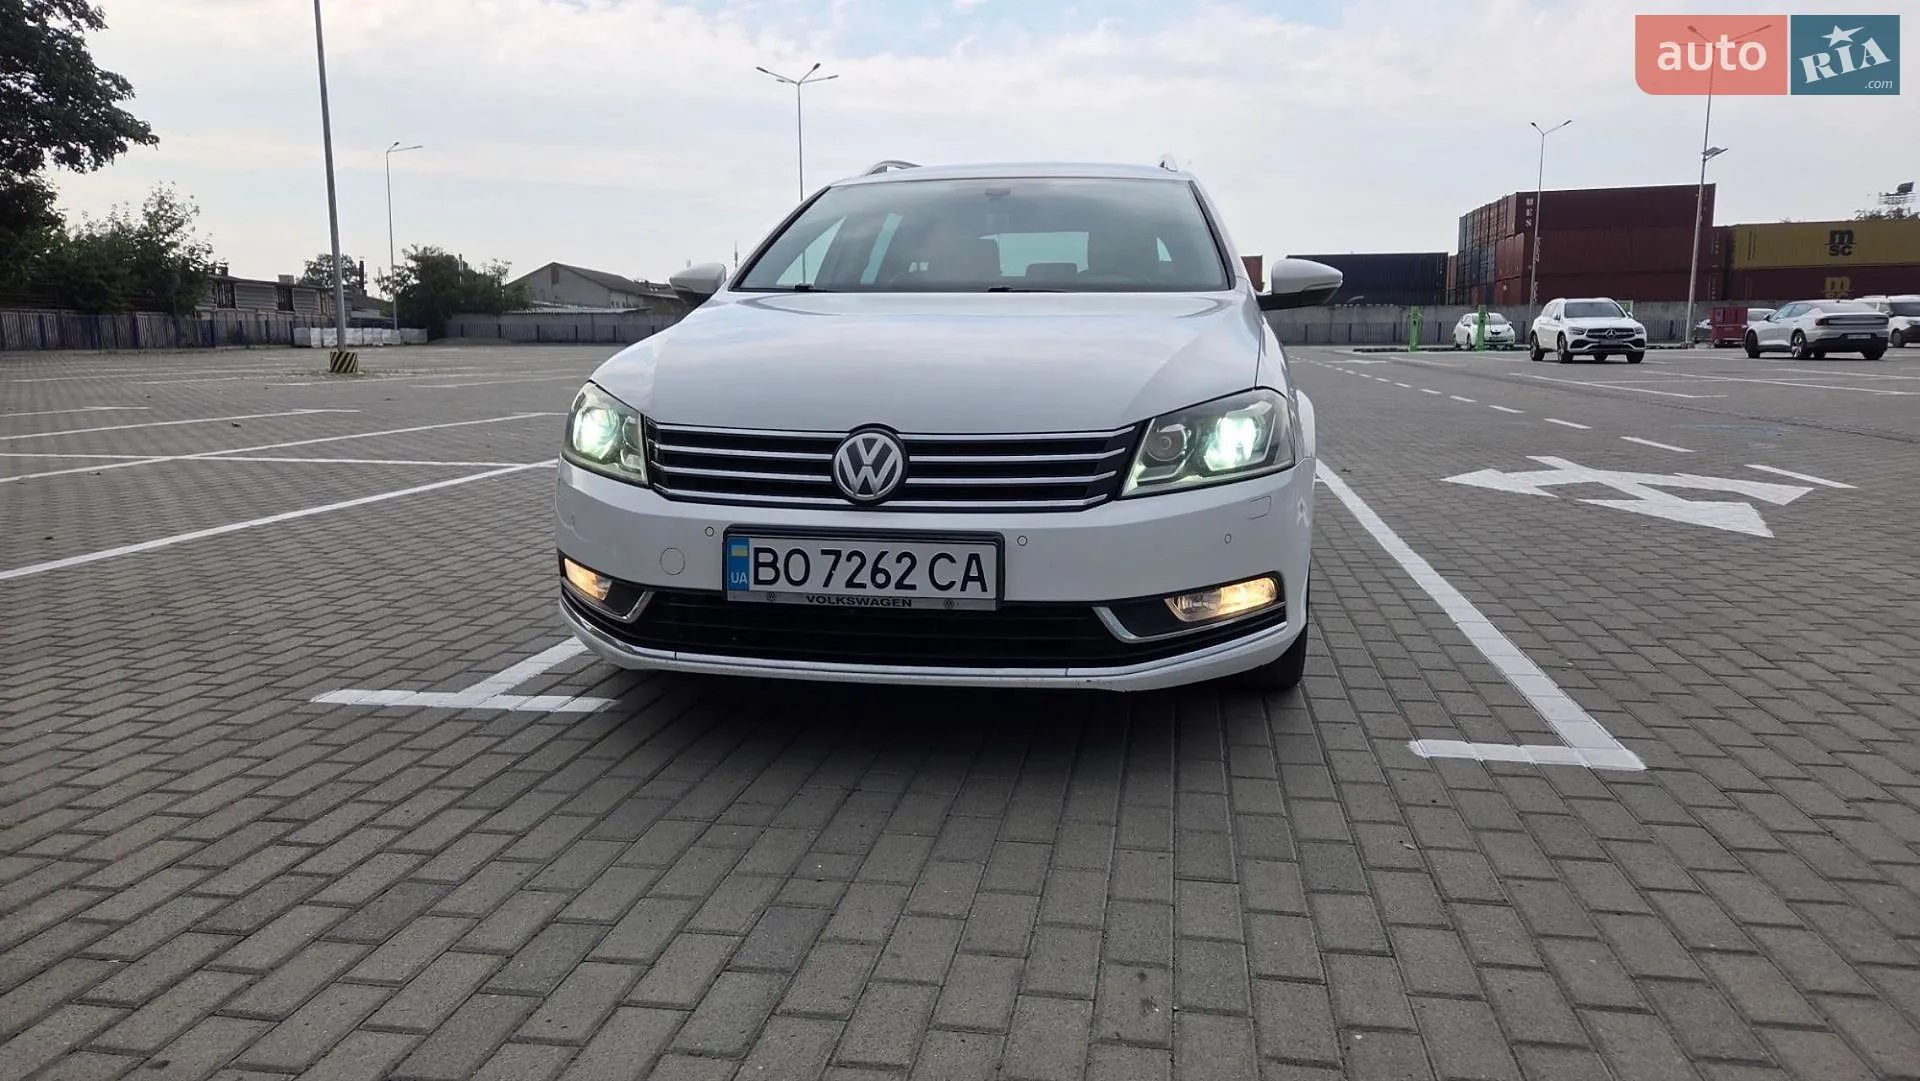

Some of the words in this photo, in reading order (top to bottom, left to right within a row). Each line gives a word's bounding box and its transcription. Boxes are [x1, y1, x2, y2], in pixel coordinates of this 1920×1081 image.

[753, 546, 811, 587] BO
[820, 549, 918, 591] 7262
[928, 551, 988, 593] CA
[730, 571, 748, 585] UA
[806, 594, 913, 608] VOLKSWAGEN
